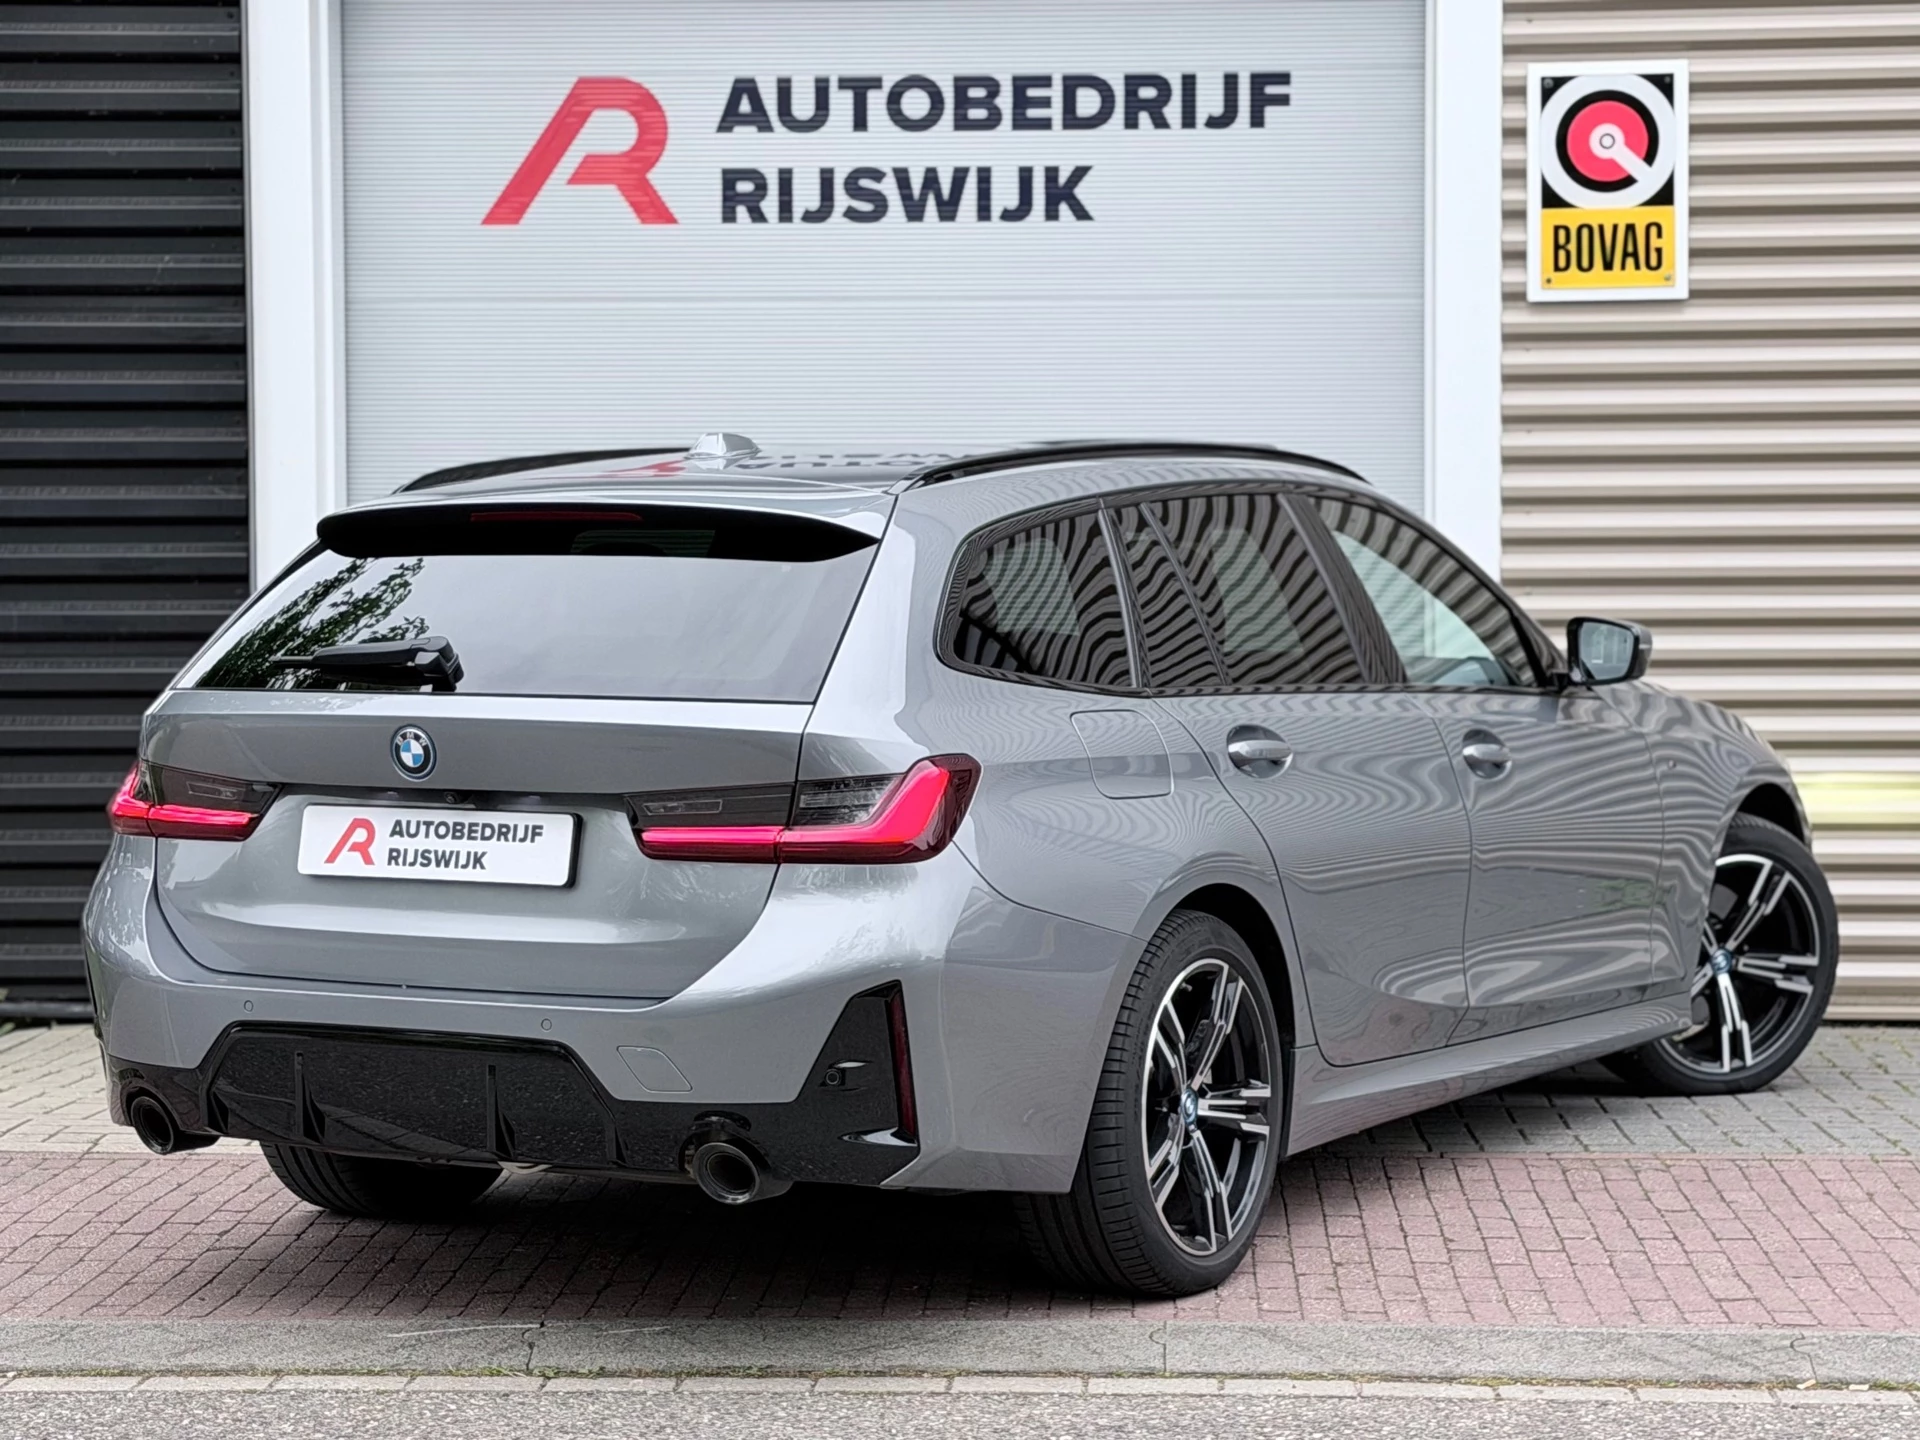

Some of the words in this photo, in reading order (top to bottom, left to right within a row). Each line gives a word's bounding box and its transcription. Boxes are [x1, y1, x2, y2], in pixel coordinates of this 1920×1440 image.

[716, 72, 1291, 133] AUTOBEDRIJF
[721, 165, 1092, 224] RIJSWIJK
[1553, 222, 1663, 273] BOVAG
[396, 731, 427, 747] BMW
[389, 819, 544, 844] AUTOBEDRIJF
[387, 847, 487, 870] RIJSWIJK
